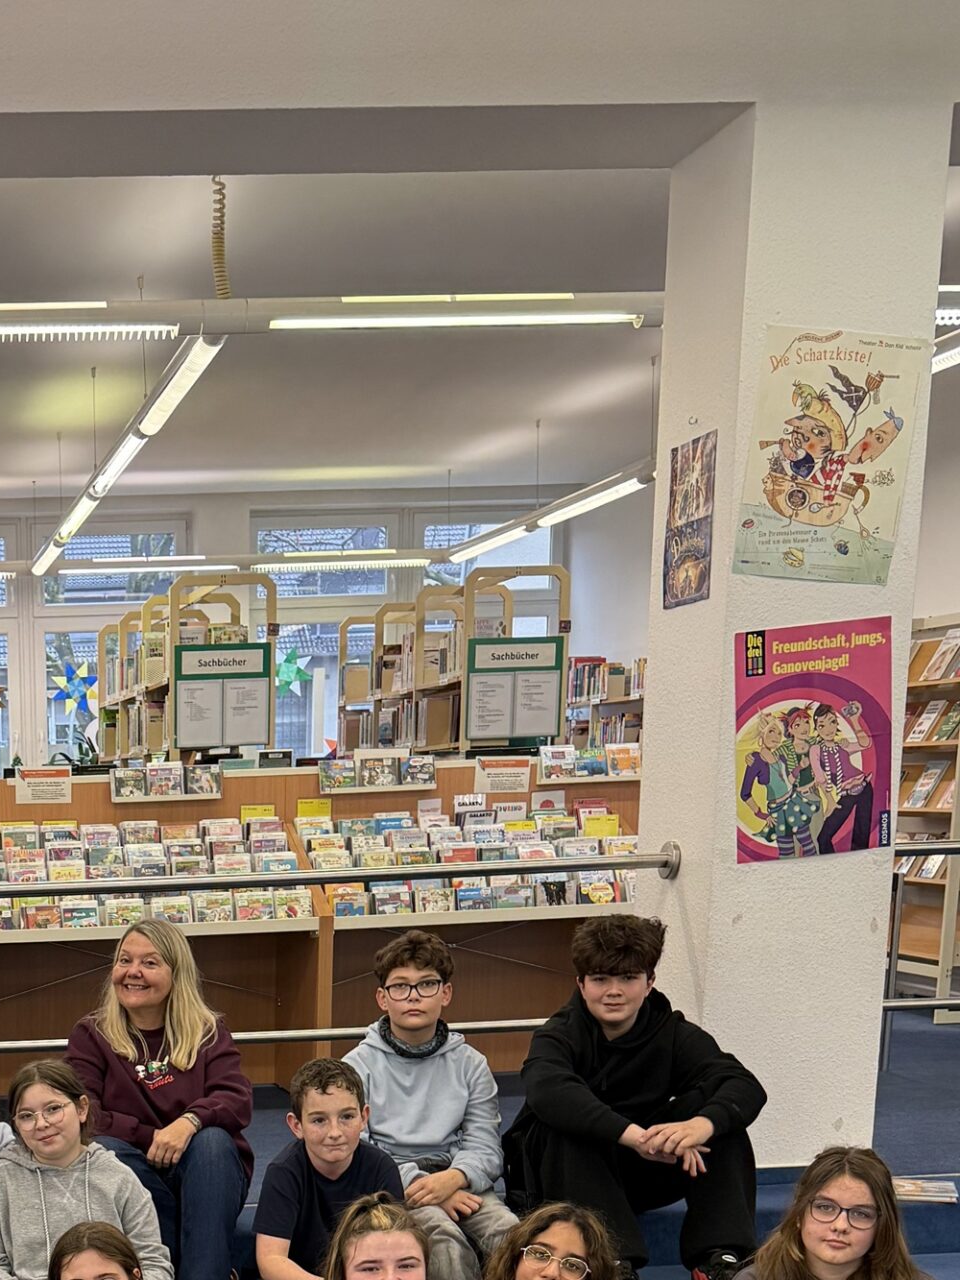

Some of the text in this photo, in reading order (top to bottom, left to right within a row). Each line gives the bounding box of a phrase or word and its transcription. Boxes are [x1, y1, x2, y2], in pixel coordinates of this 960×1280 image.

[769, 346, 873, 373] Die Schatzkiste!
[747, 634, 763, 648] Die
[772, 632, 886, 654] Freundschaft, Jungs,
[491, 651, 540, 661] Sachbücher
[747, 647, 763, 658] drei
[198, 657, 247, 667] Sachbücher
[772, 654, 850, 675] Ganovenjagd!
